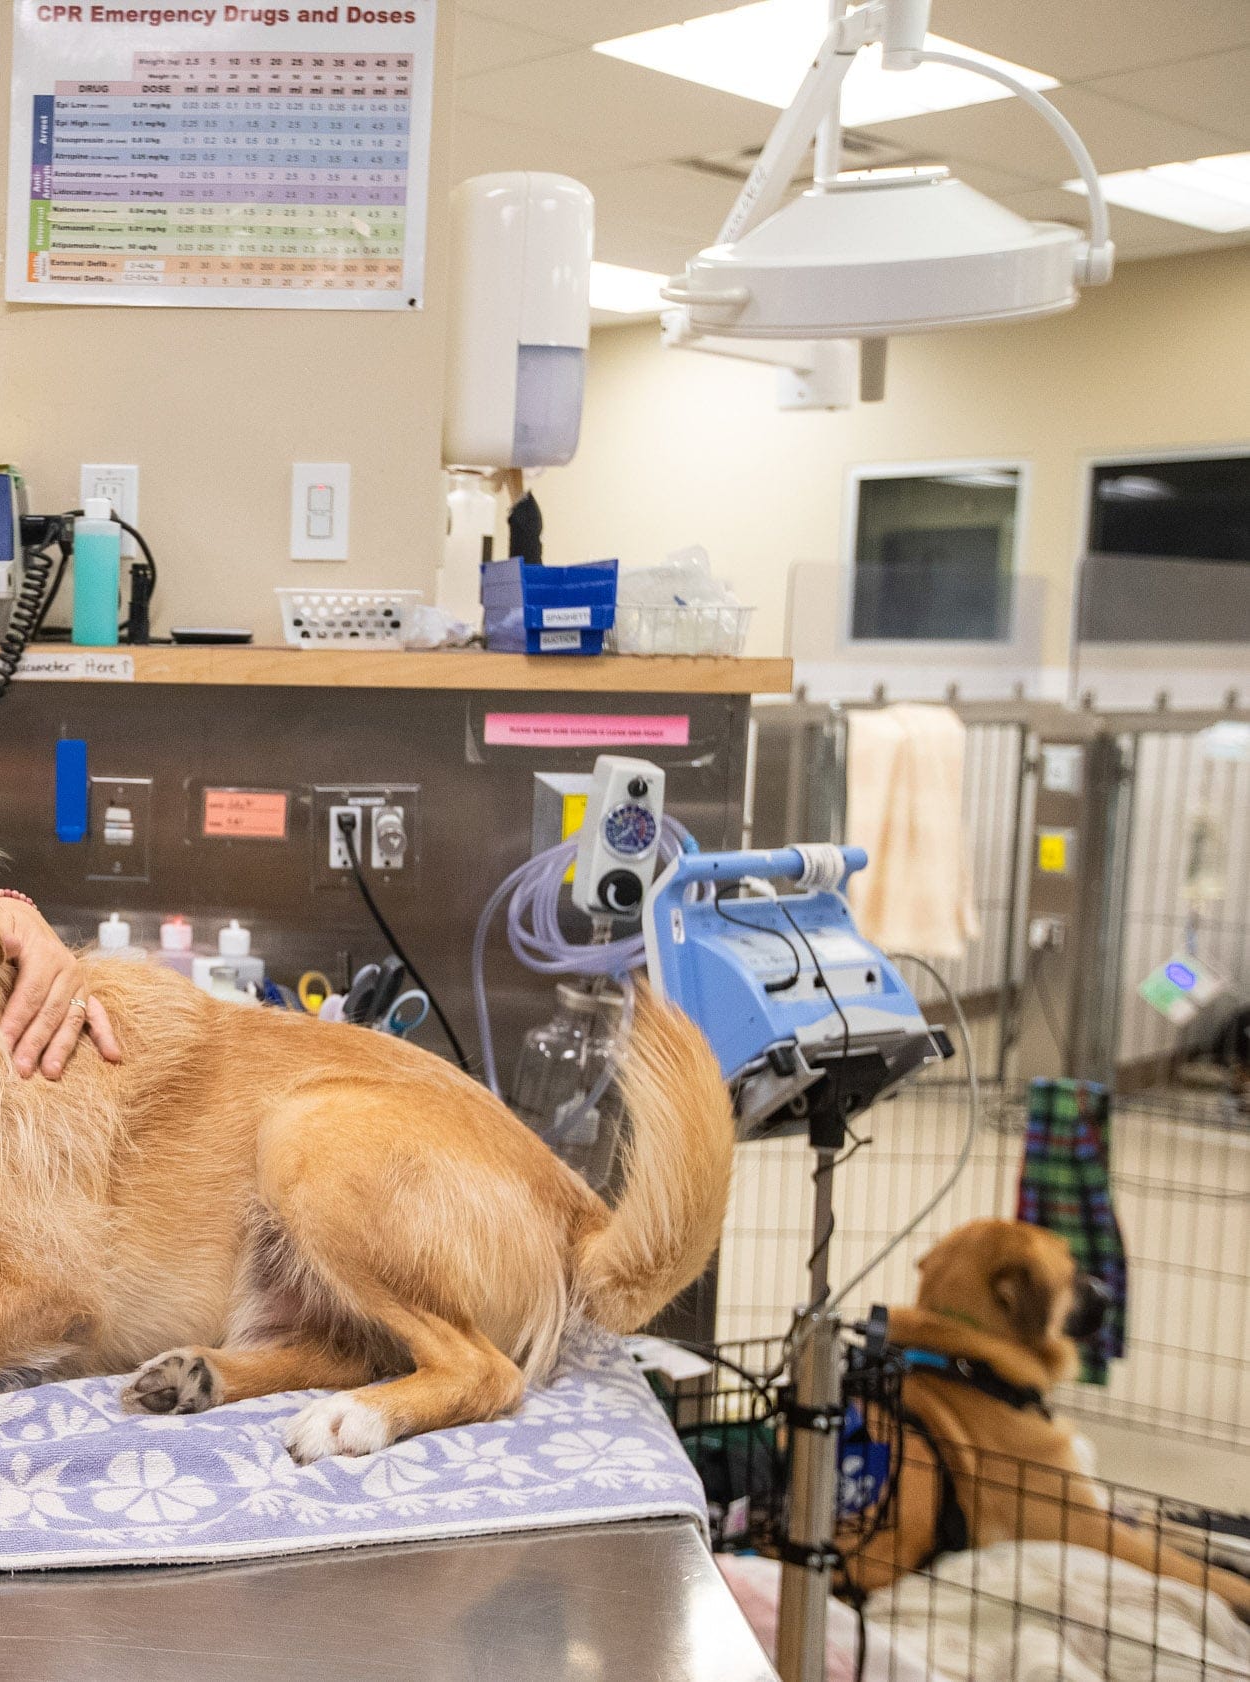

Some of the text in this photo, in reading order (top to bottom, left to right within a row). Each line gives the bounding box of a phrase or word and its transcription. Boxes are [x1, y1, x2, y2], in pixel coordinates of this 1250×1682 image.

[37, 5, 416, 26] CPR Emergency Drugs and Doses
[228, 58, 240, 66] 10
[250, 58, 261, 66] 15
[269, 58, 282, 66] 20
[291, 59, 303, 67] 25
[333, 59, 345, 67] 35
[354, 59, 366, 67] 40
[375, 60, 388, 68] 45
[78, 85, 109, 93] DRUG
[142, 85, 172, 93] DOSE
[39, 115, 48, 144] Arrest
[85, 659, 117, 674] Here
